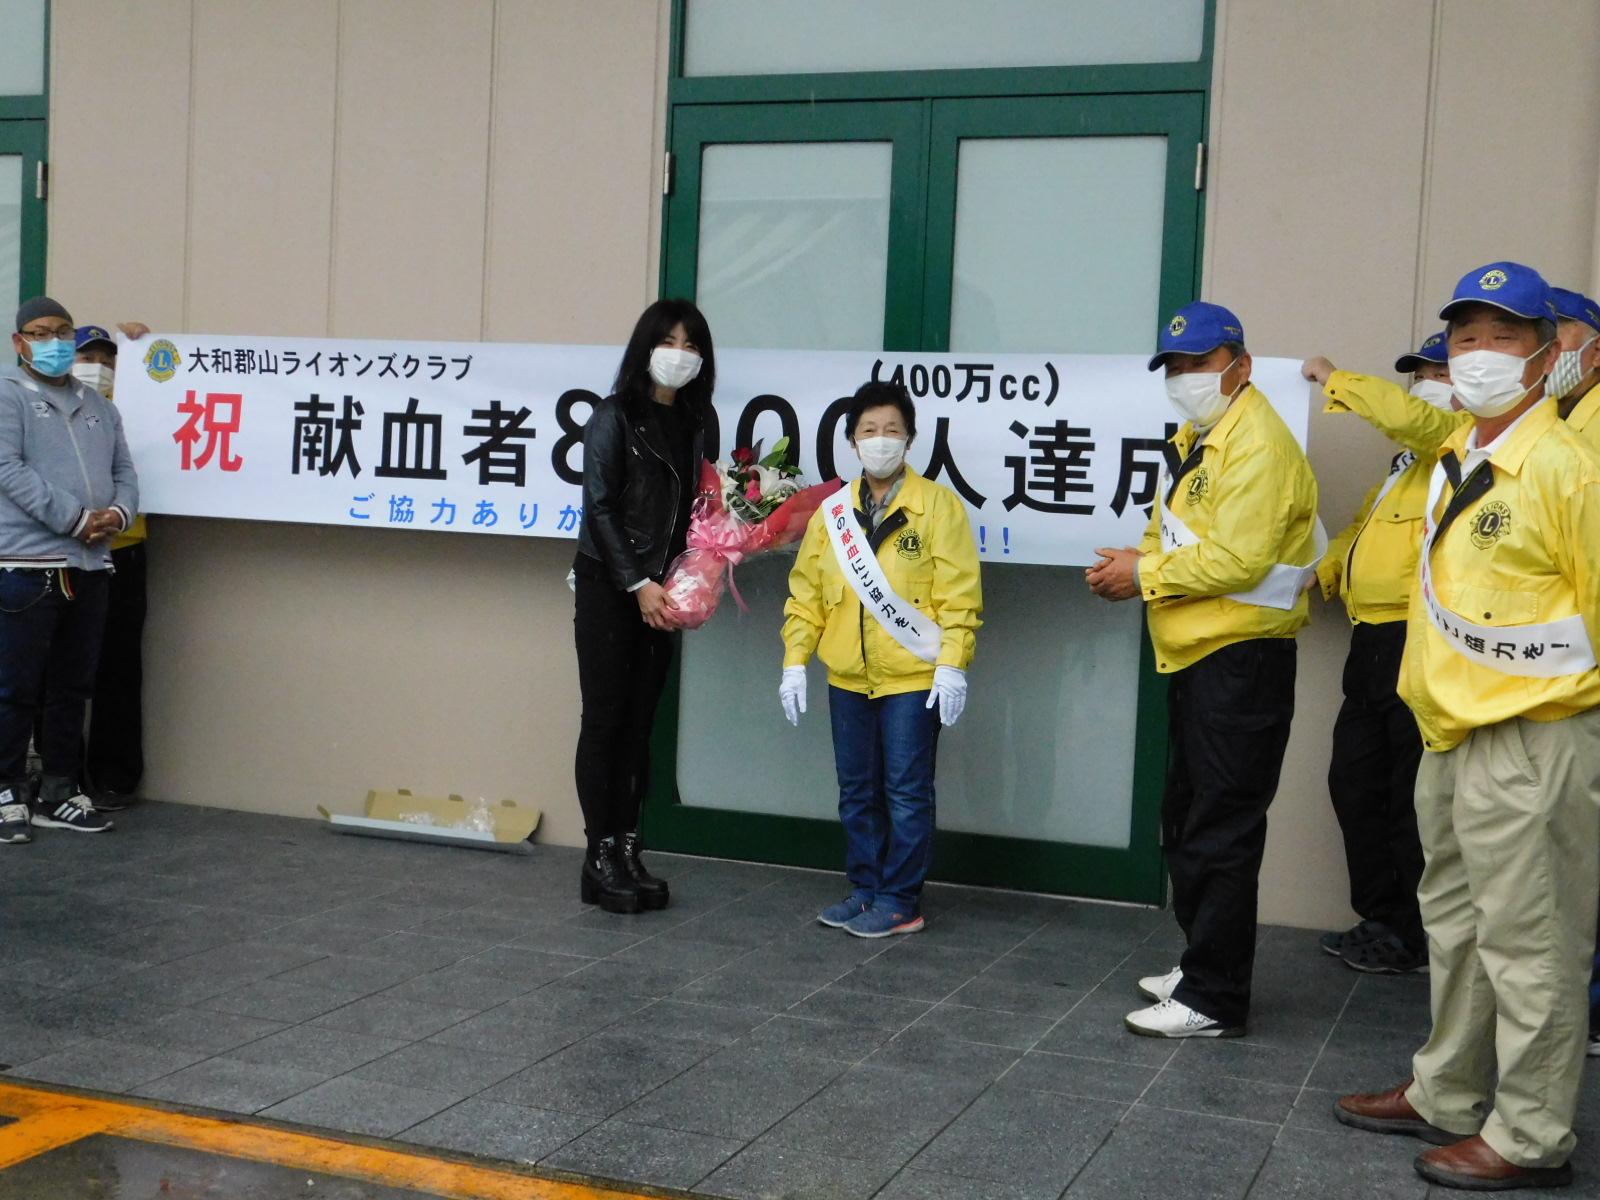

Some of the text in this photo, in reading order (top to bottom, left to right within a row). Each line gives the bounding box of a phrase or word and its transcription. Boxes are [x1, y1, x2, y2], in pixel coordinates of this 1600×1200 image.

[188, 347, 473, 381] 大和郡山ライオンズクラブ
[172, 389, 244, 473] 祝
